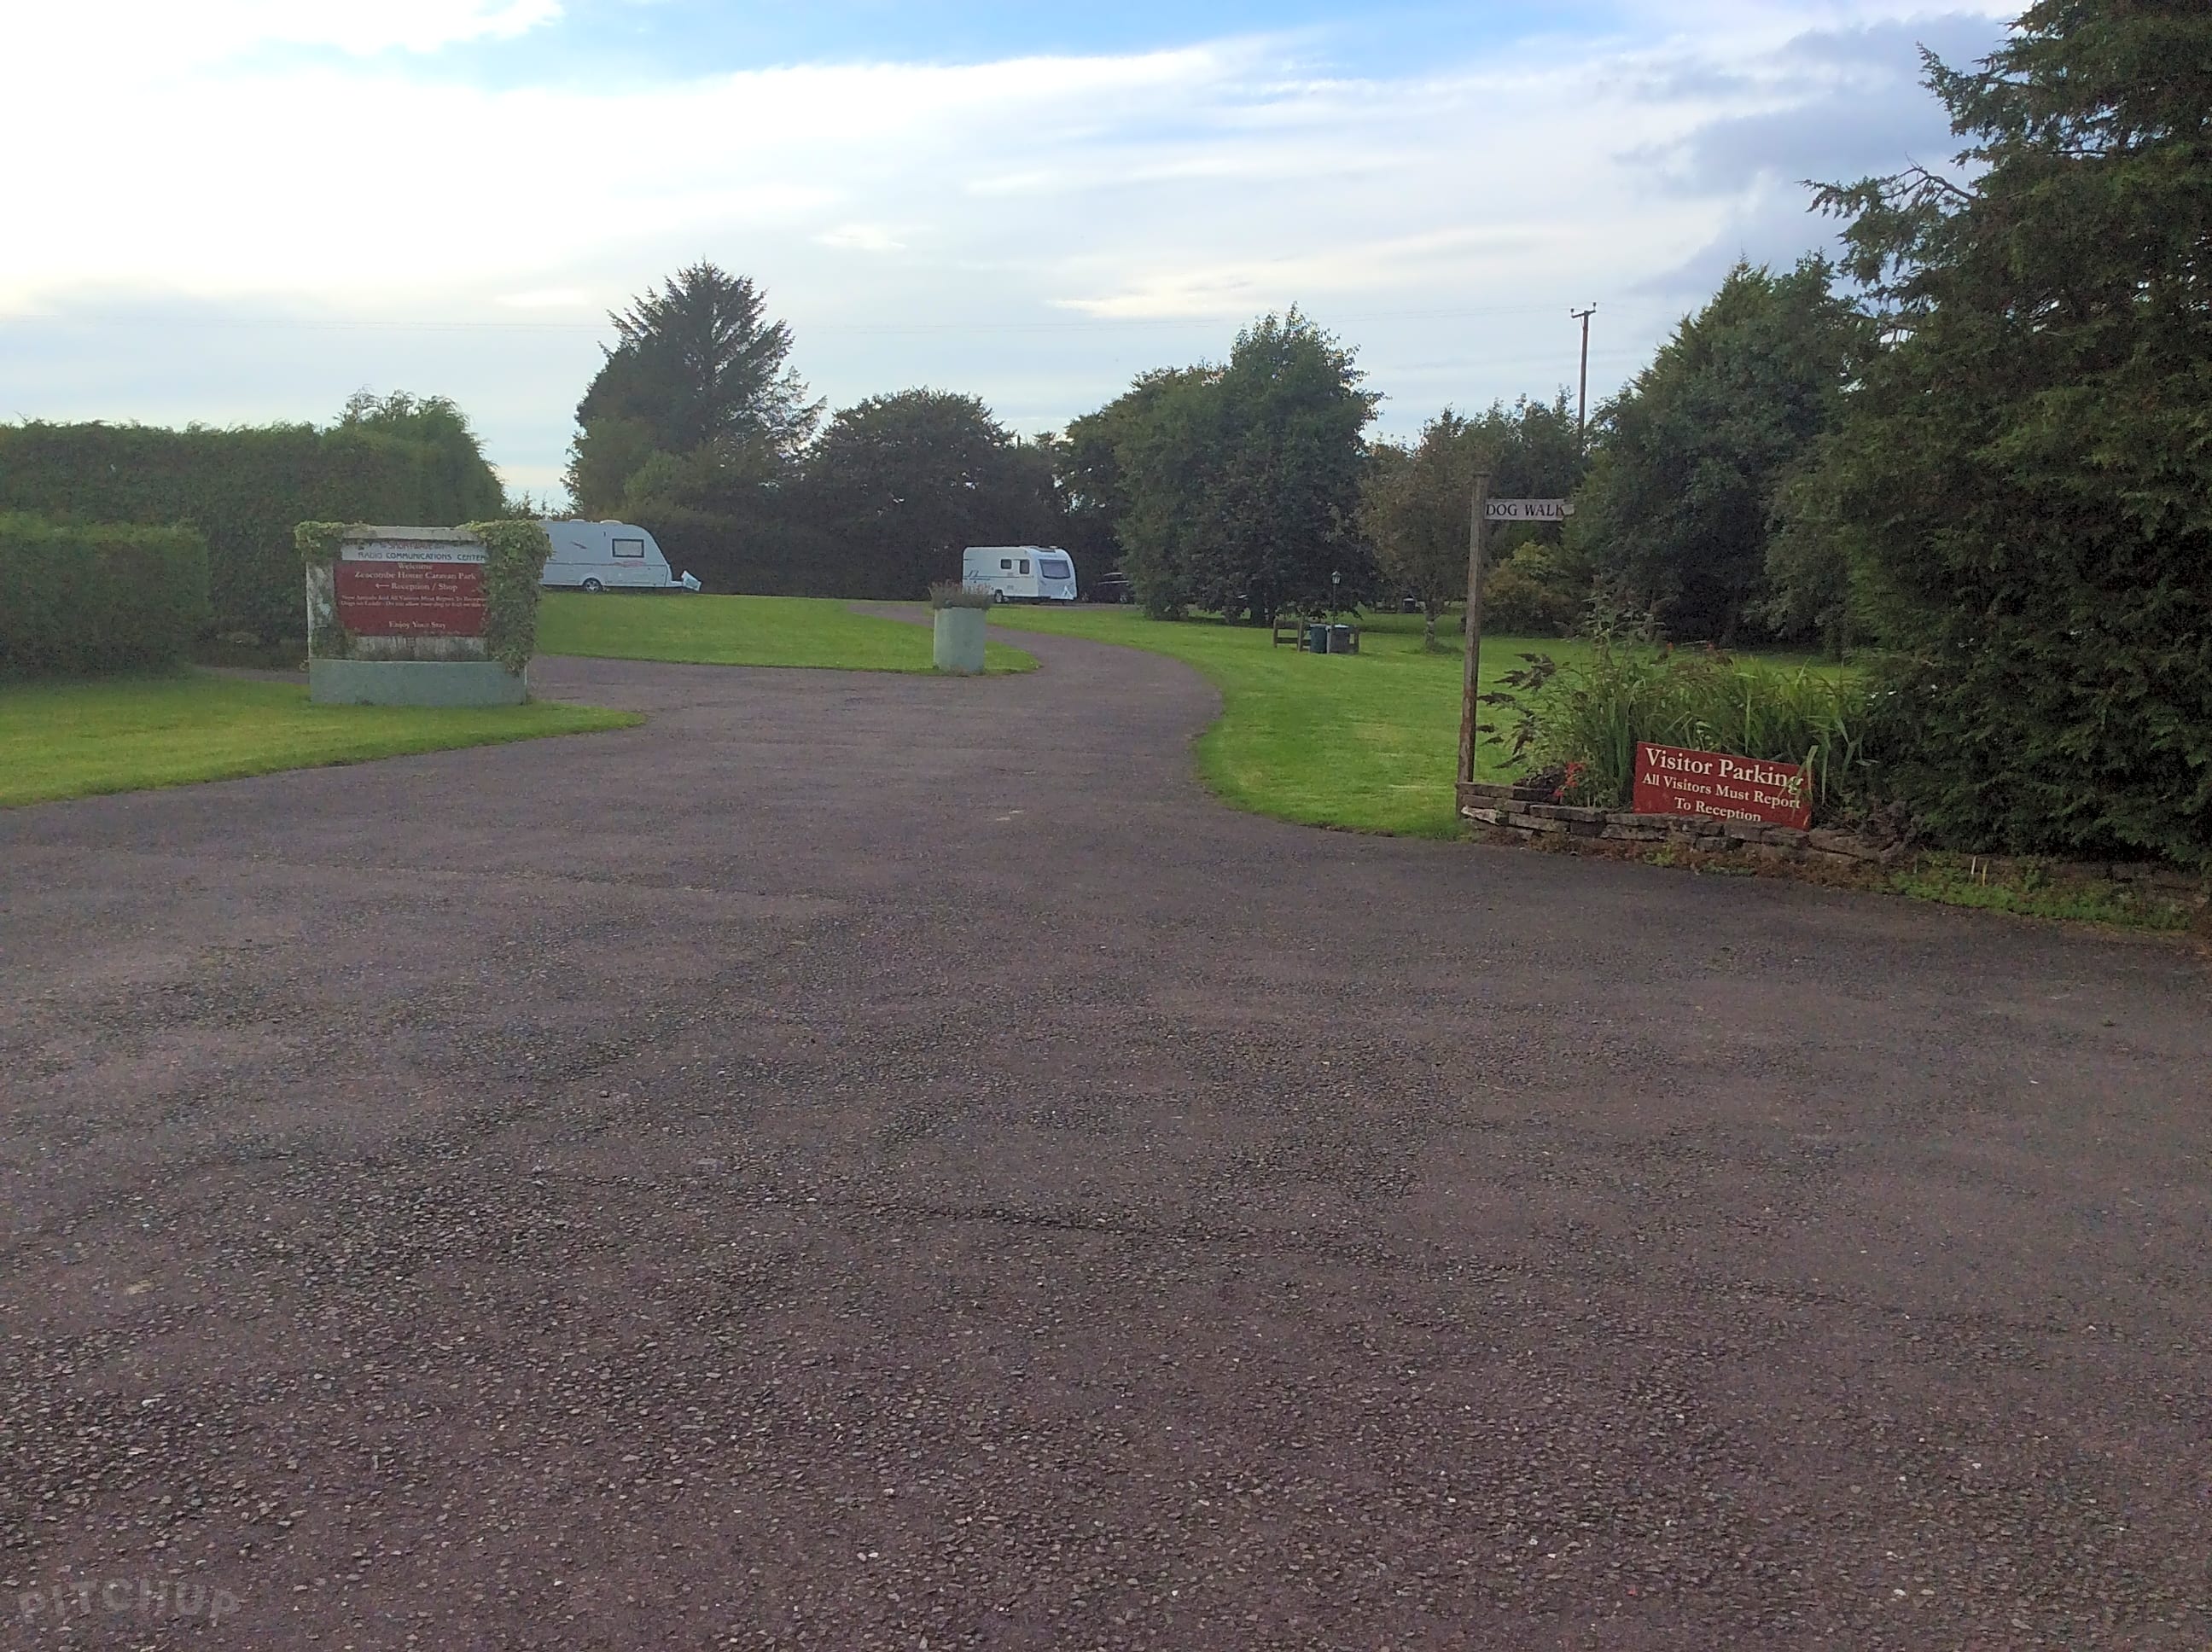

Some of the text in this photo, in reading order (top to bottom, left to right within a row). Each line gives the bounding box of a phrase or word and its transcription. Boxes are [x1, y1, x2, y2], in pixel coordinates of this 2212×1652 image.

[1486, 503, 1564, 517] DOG WALK
[386, 552, 452, 561] COMMUNICATIONS
[398, 571, 423, 579] House
[458, 572, 476, 580] Park
[391, 582, 430, 591] Reception
[438, 583, 458, 592] Shop
[388, 620, 410, 629] Enjoy
[431, 621, 445, 630] Stay
[1644, 747, 1804, 795] Visitor Parking
[1642, 772, 1801, 809] All Visitors Must Report
[1674, 796, 1762, 822] To Reception
